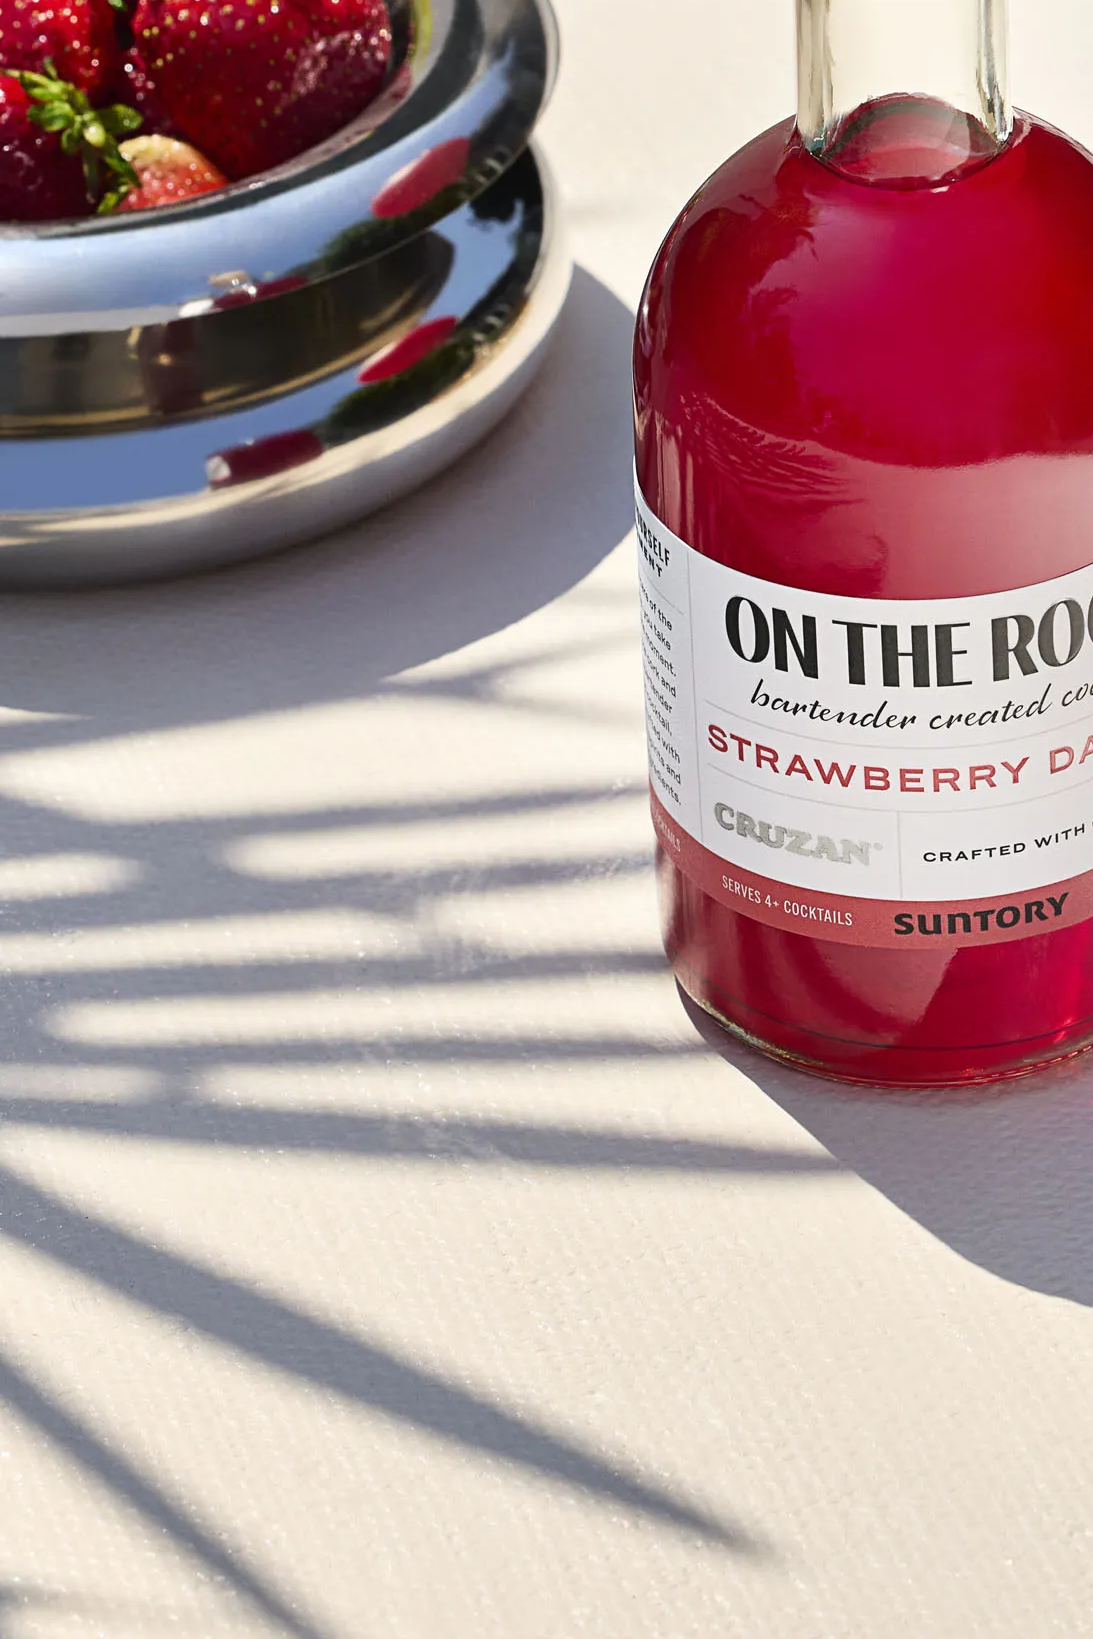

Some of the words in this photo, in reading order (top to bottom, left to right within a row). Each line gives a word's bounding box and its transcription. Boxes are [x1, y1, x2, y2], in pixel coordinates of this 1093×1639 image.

[653, 624, 672, 651] take
[657, 608, 673, 632] the
[725, 596, 819, 679] ON
[832, 619, 972, 688] THE
[660, 674, 677, 698] and
[750, 678, 917, 730] bartender
[929, 683, 1052, 730] created
[666, 762, 682, 785] and
[708, 724, 1030, 793] STRAWBERRY
[923, 842, 1026, 862] CRAFTED
[1034, 826, 1085, 849] WITH
[722, 875, 761, 904] SERVES
[764, 894, 780, 908] 4+
[784, 900, 853, 927] COCKTAILS
